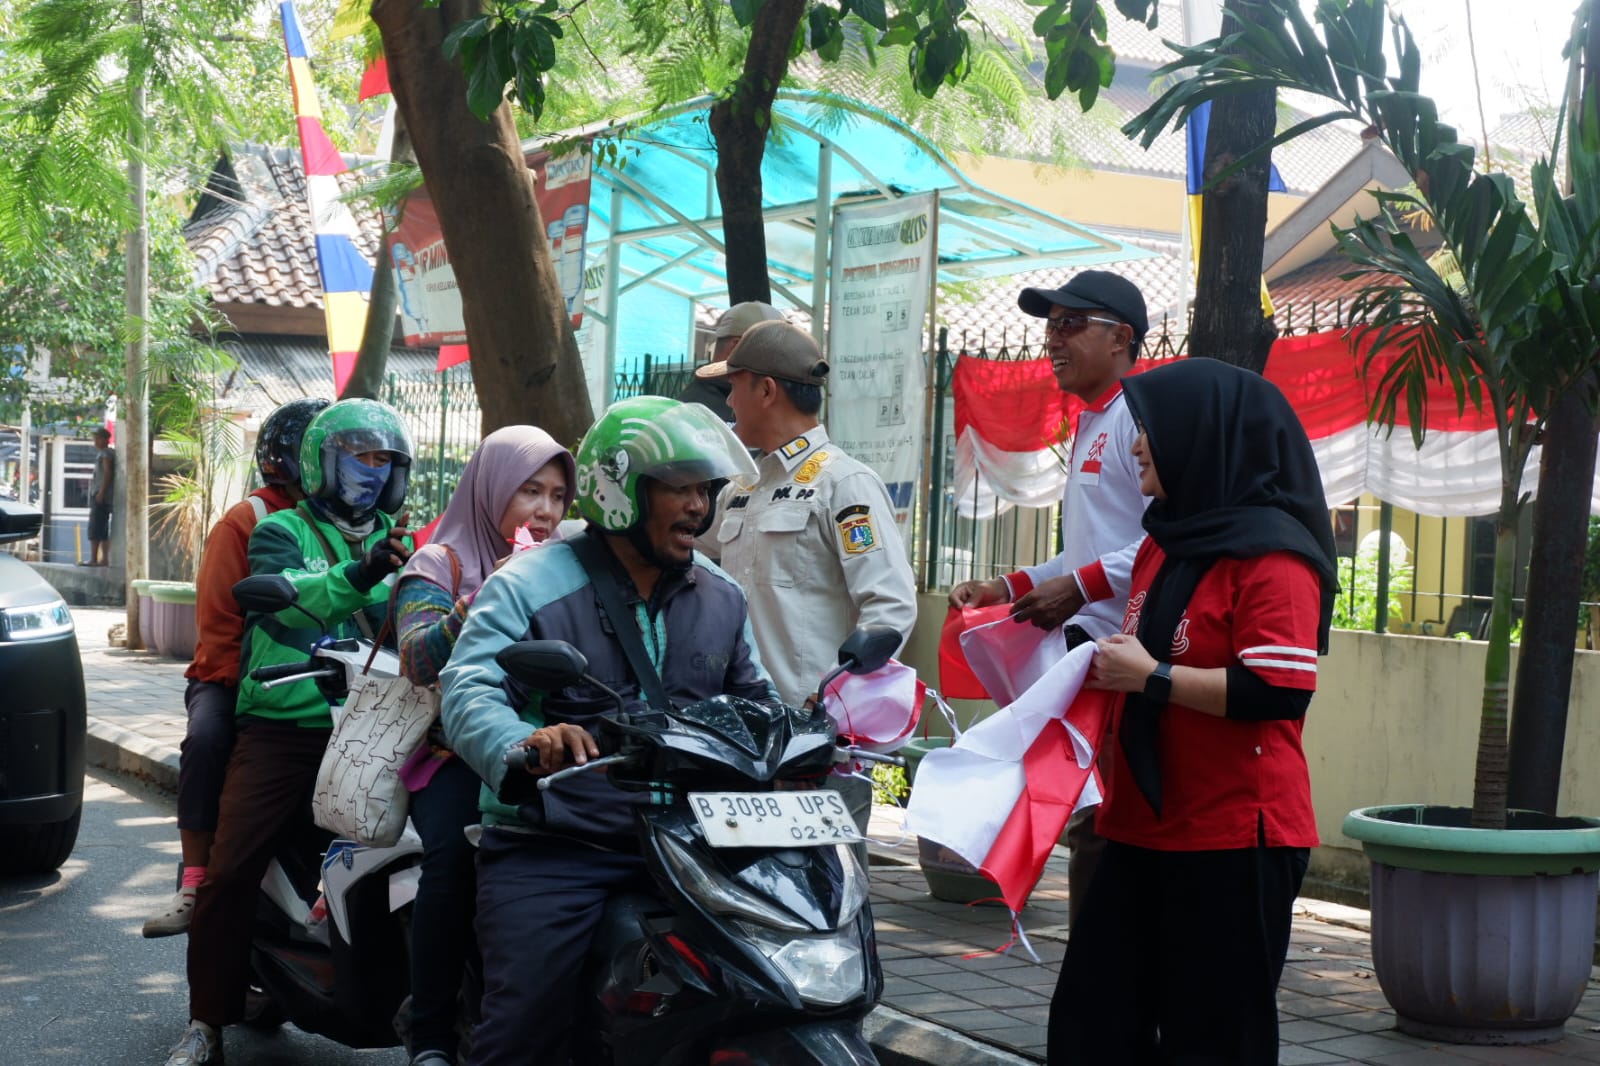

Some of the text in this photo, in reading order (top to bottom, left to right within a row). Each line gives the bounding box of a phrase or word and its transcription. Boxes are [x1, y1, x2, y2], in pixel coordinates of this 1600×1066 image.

[795, 488, 815, 500] PP
[696, 794, 844, 818] B 3088 UPS
